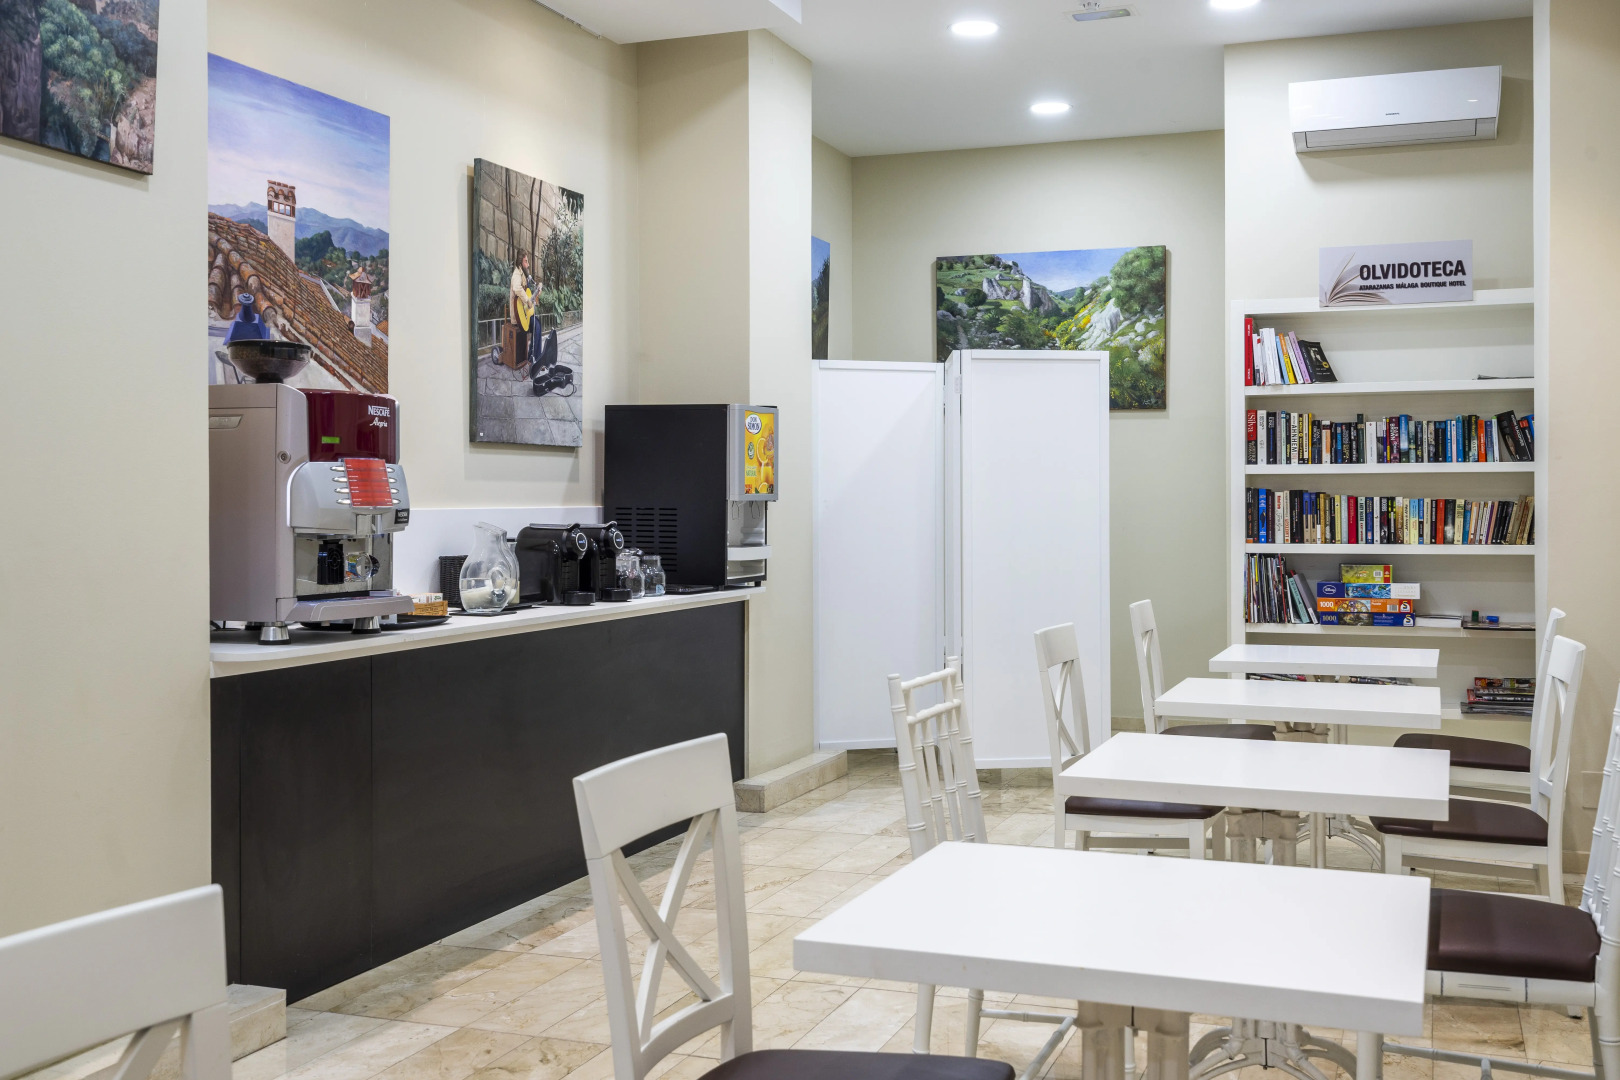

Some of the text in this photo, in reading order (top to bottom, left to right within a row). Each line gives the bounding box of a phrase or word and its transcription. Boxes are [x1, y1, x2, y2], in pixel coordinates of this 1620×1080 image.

[1359, 260, 1467, 281] OLVIDOTECA
[1359, 283, 1394, 291] ATARAZANAS
[1395, 281, 1419, 289] MÁLAGA
[1420, 280, 1447, 288] BOUTIQUE
[368, 405, 390, 417] NESCAFÉ
[1247, 414, 1256, 433] Silva
